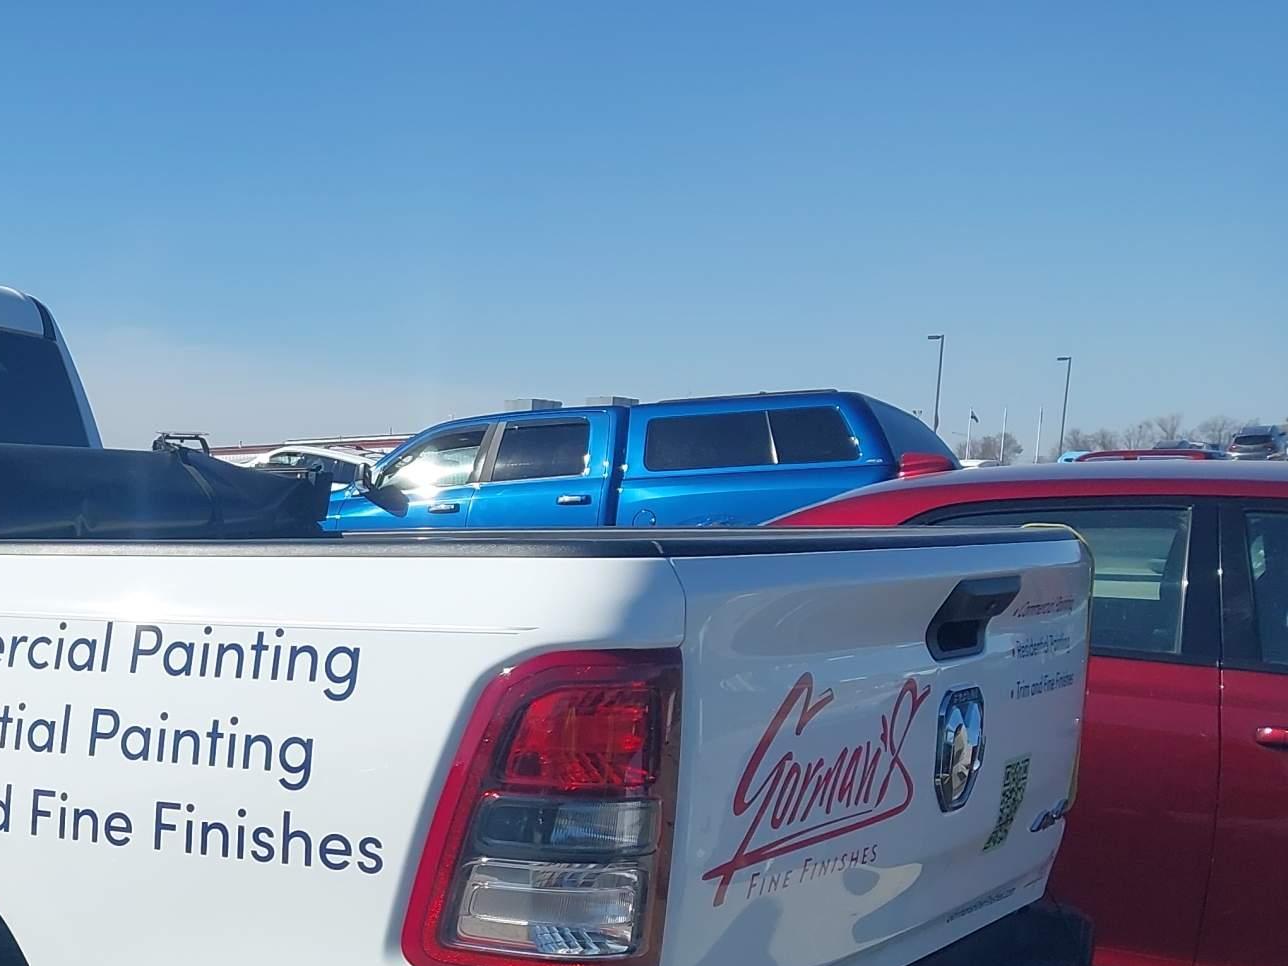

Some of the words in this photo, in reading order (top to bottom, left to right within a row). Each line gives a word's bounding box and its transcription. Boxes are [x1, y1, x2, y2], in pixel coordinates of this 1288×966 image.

[128, 624, 362, 703] Painting
[87, 707, 315, 792] Painting
[29, 788, 133, 848] Fine
[153, 801, 385, 875] Finishes
[746, 870, 794, 900] FINE
[799, 843, 879, 884] FINISHES
